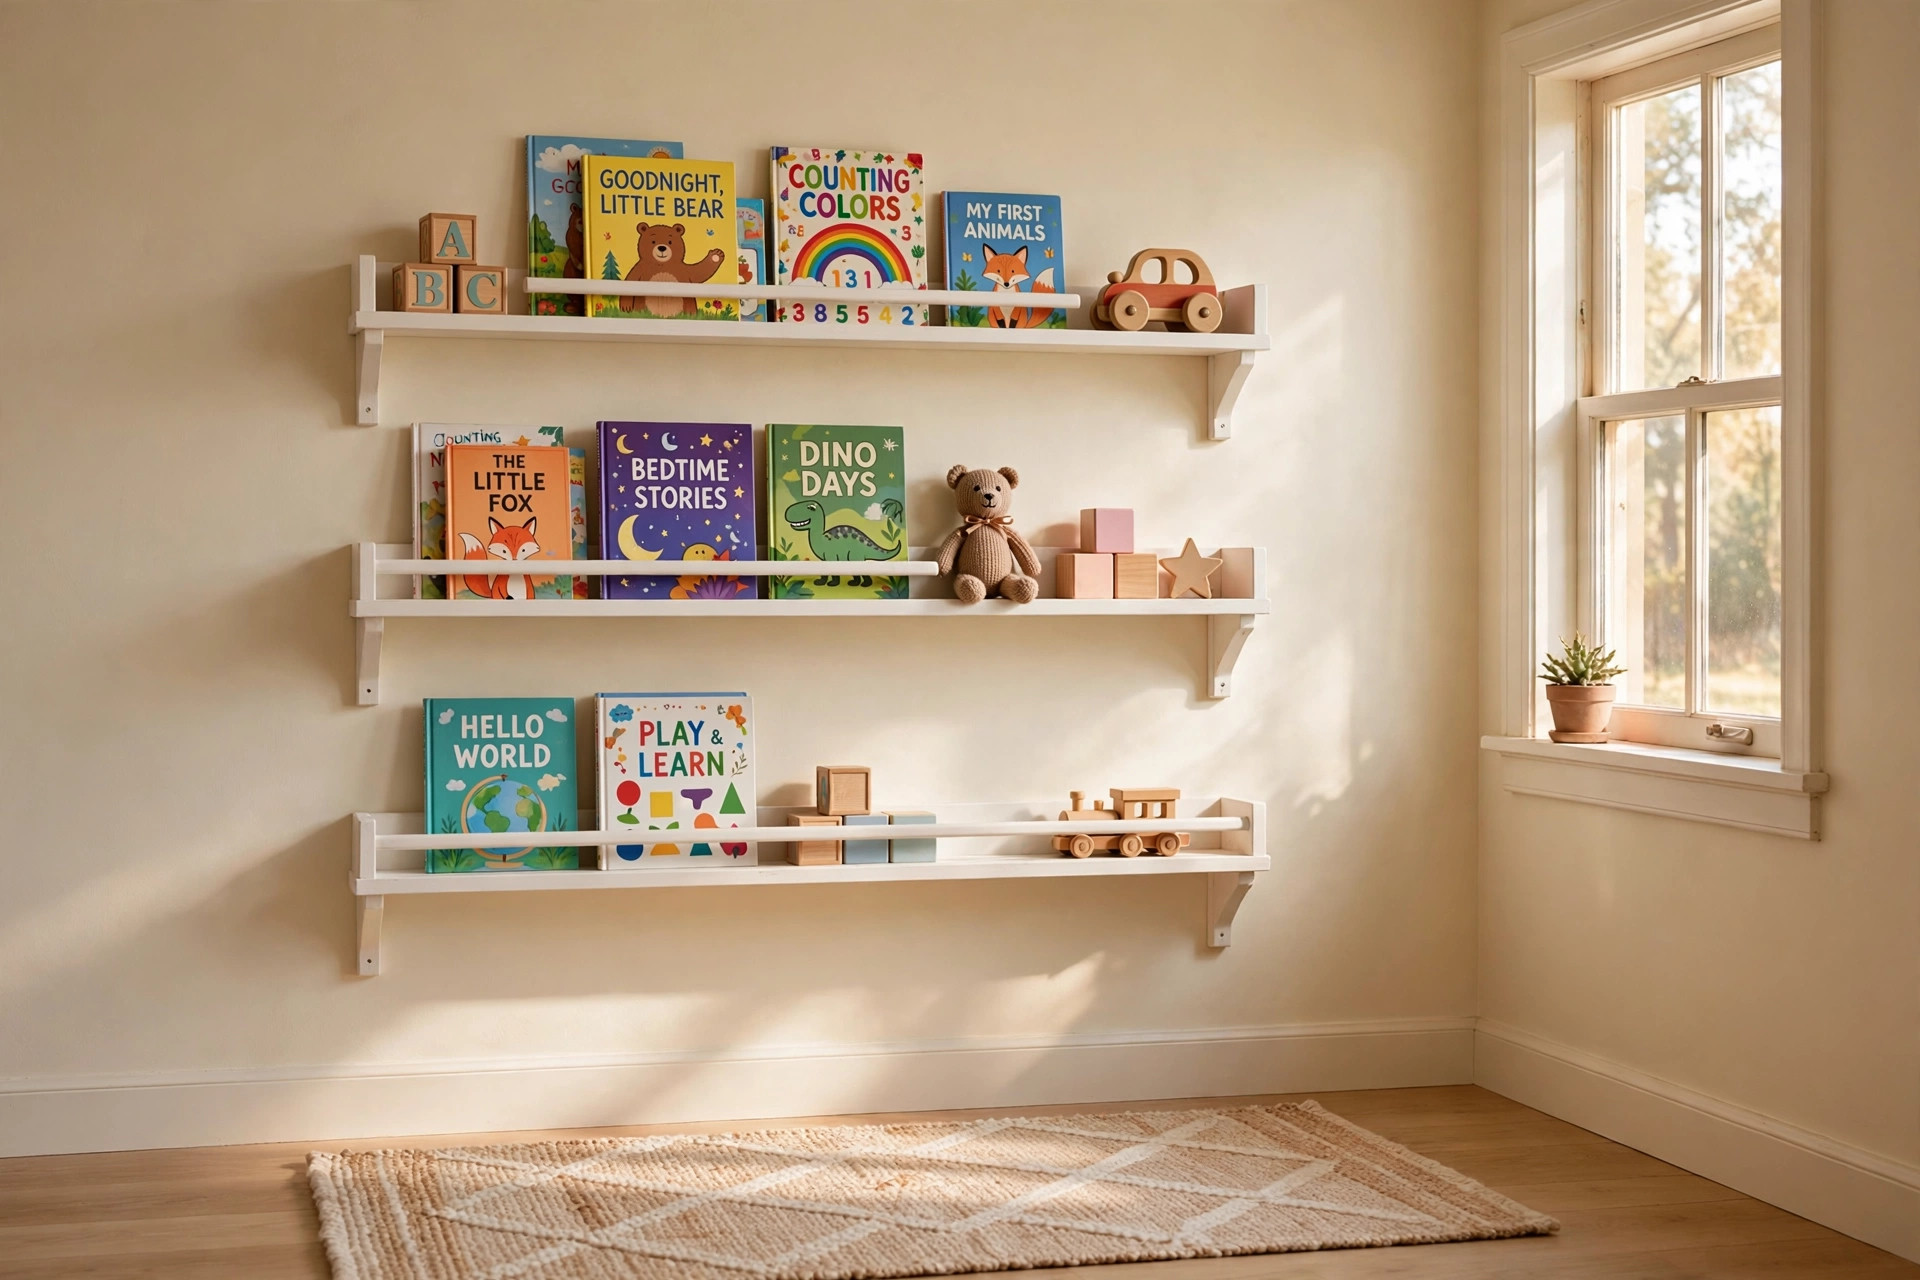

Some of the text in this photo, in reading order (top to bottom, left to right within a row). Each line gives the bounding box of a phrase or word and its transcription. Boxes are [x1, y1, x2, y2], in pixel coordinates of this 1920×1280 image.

[600, 169, 724, 197] GOODNIGHT,
[788, 163, 910, 194] COUNTING
[601, 193, 724, 219] LITTLE BEAR
[799, 191, 901, 222] COLORS
[966, 202, 1042, 222] MY FIRST
[436, 221, 471, 257] A
[963, 221, 1046, 242] ANIMALS
[411, 271, 444, 307] B
[466, 272, 498, 309] C
[492, 454, 525, 468] THE
[800, 440, 877, 468] DINO
[474, 471, 545, 491] LITTLE
[631, 457, 730, 482] BEDTIME
[801, 470, 877, 497] DAYS
[489, 493, 533, 513] FOX
[634, 485, 728, 510] STORIES
[461, 714, 544, 739] HELLO
[640, 720, 724, 746] PLAY &
[453, 743, 551, 769] WORLD
[638, 751, 725, 778] LEARN
